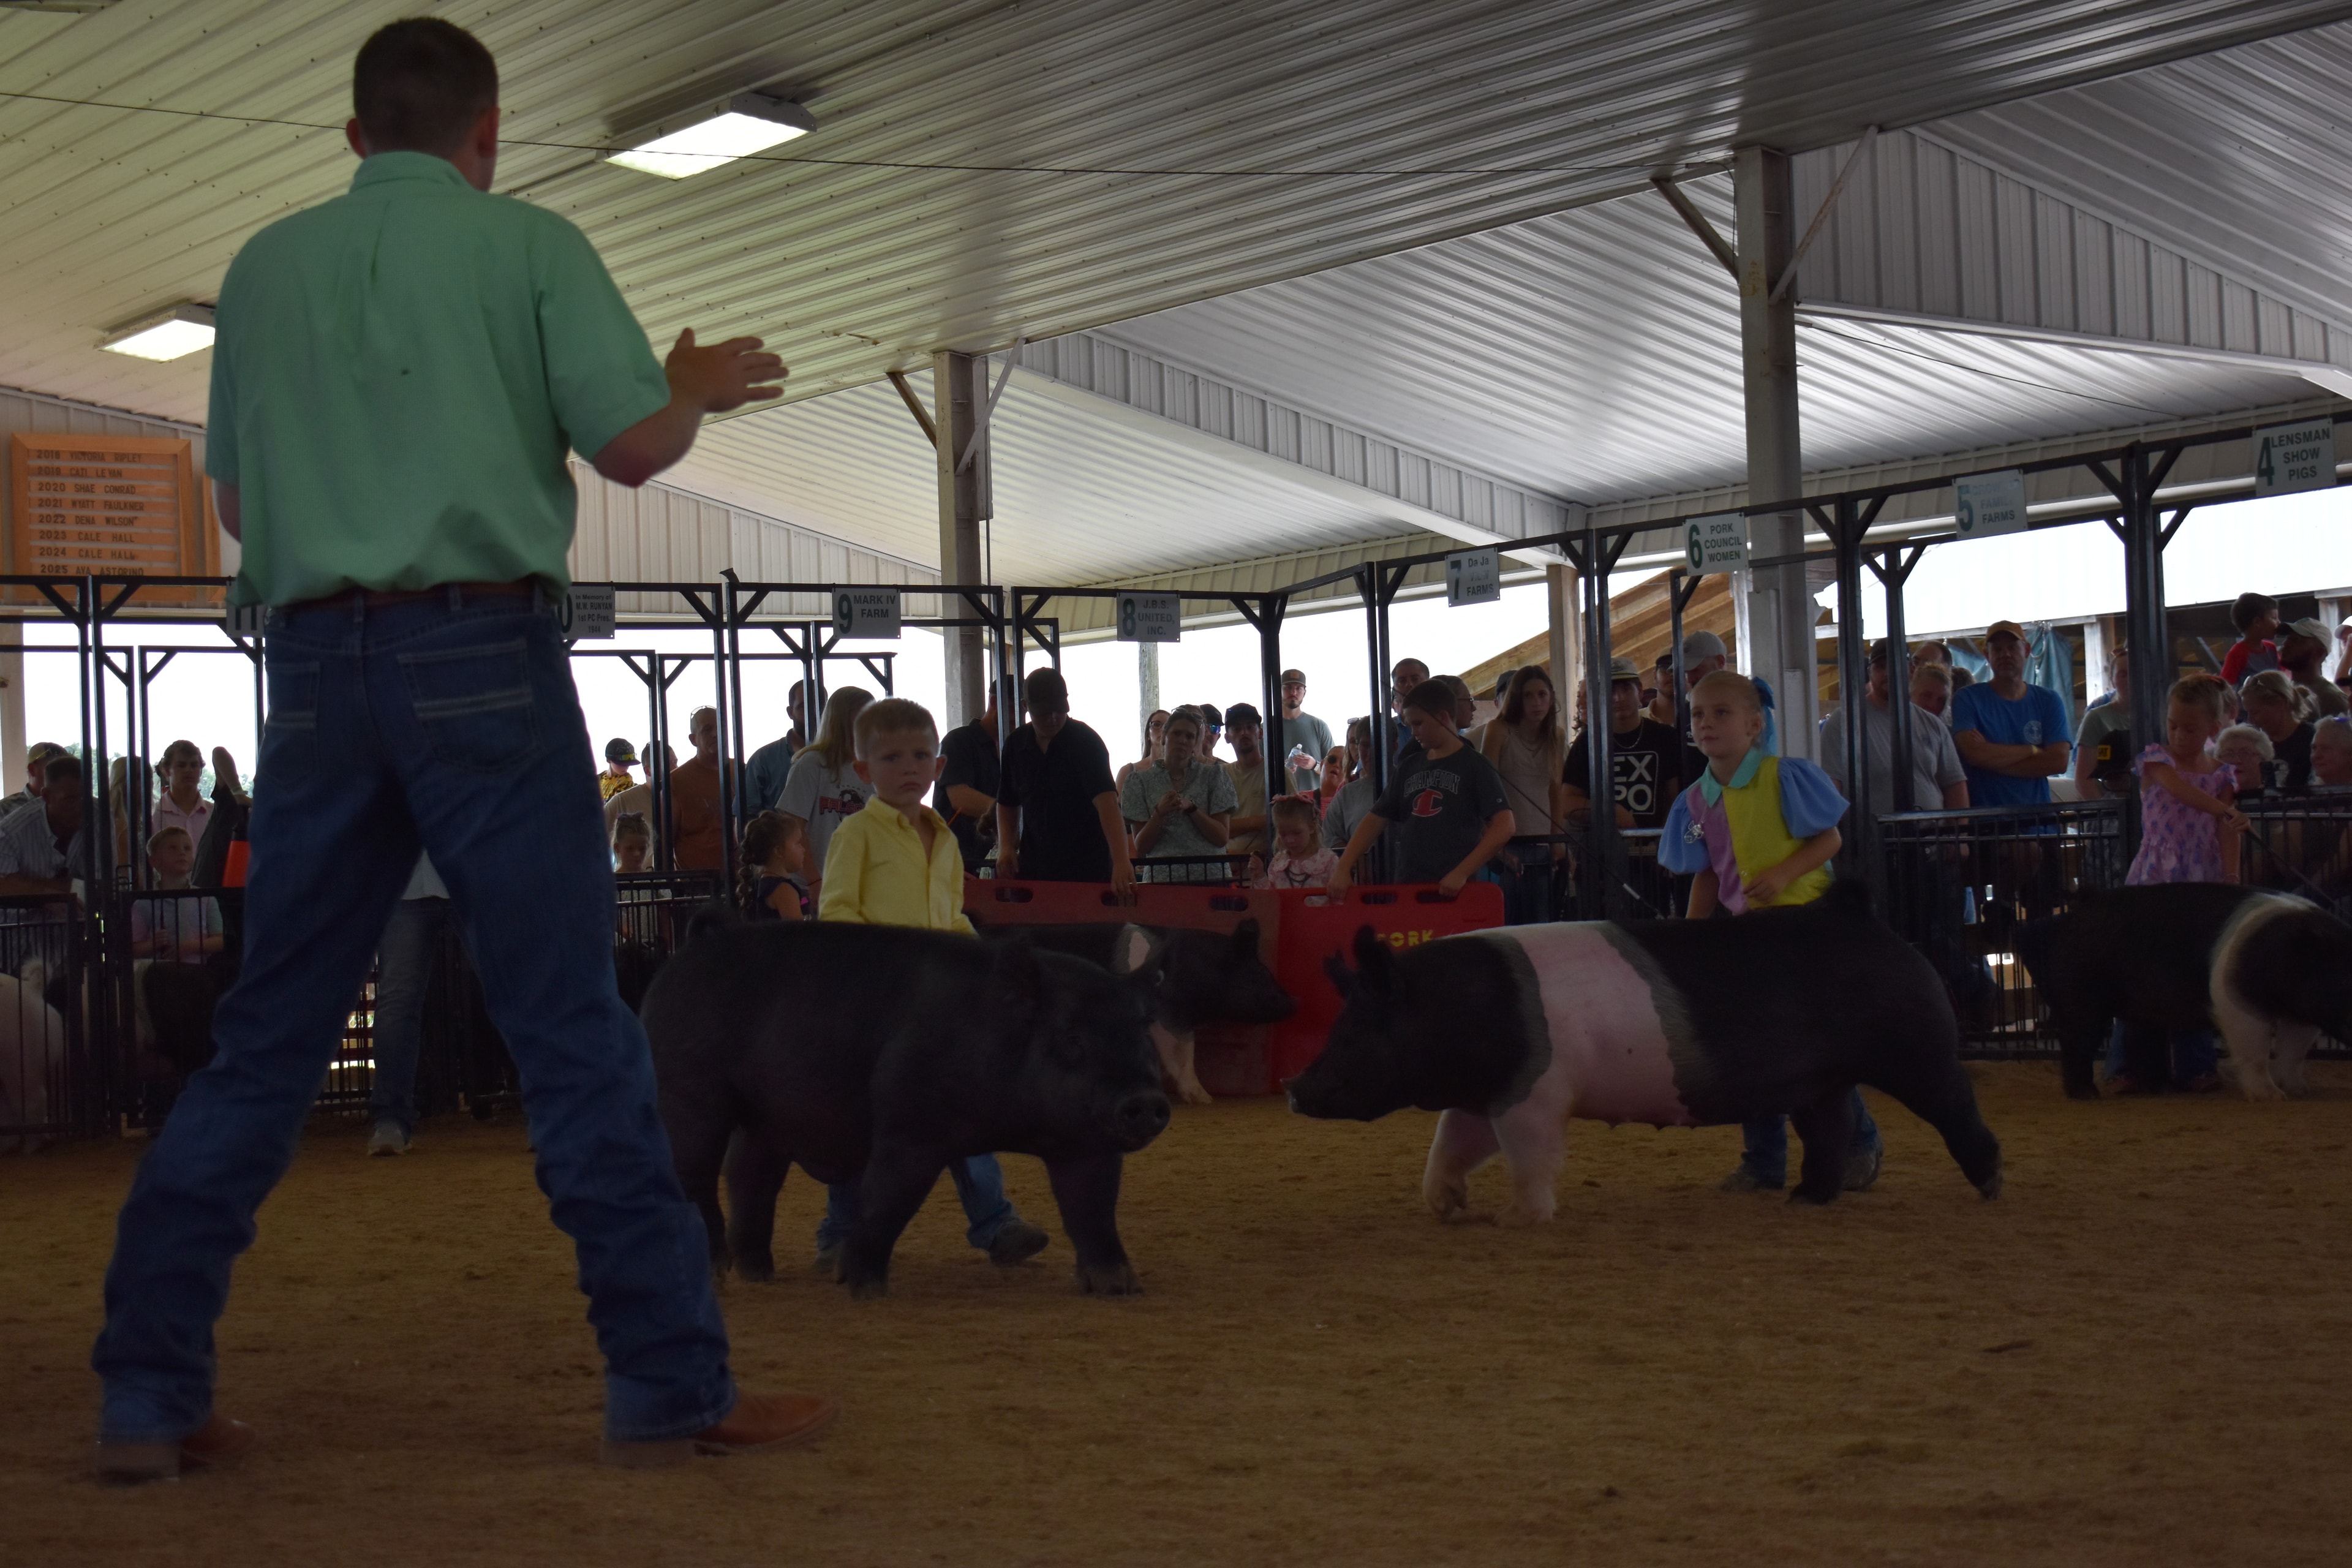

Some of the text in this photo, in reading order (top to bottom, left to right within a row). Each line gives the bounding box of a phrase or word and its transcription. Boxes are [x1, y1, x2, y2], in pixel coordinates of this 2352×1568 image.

[2271, 428, 2330, 448] LENSMAN
[2258, 436, 2274, 486] 4
[2283, 447, 2320, 464] SHOW
[2288, 466, 2317, 481] PIGS
[38, 483, 136, 495] 2020 SHAE CONRAD
[38, 499, 144, 511] 2021 WYATT FAULKNER
[1958, 485, 1973, 532] 5
[39, 514, 66, 524] 2022
[75, 516, 96, 525] DENA
[1982, 510, 2015, 524] FARMS
[1710, 523, 1734, 534] PORK
[39, 531, 135, 543] 2023 CALE HALL
[1705, 537, 1742, 549] COUNCIL
[1689, 524, 1702, 568] 6
[39, 548, 66, 556] 2024
[78, 549, 102, 559] CALE
[1708, 550, 1740, 562] WOMEN
[1450, 560, 1461, 600] 7
[1467, 583, 1494, 597] FARMS
[853, 595, 896, 605] MARK IV
[1143, 600, 1169, 609] J.B.S.
[838, 594, 853, 634] 9
[861, 609, 889, 618] FARM
[1122, 598, 1136, 637] 8
[1138, 612, 1175, 624] UNITED,
[1147, 626, 1166, 635] INC.
[1613, 755, 1653, 783] EX
[1403, 769, 1461, 797] CHAMPION
[1614, 783, 1653, 811] PO
